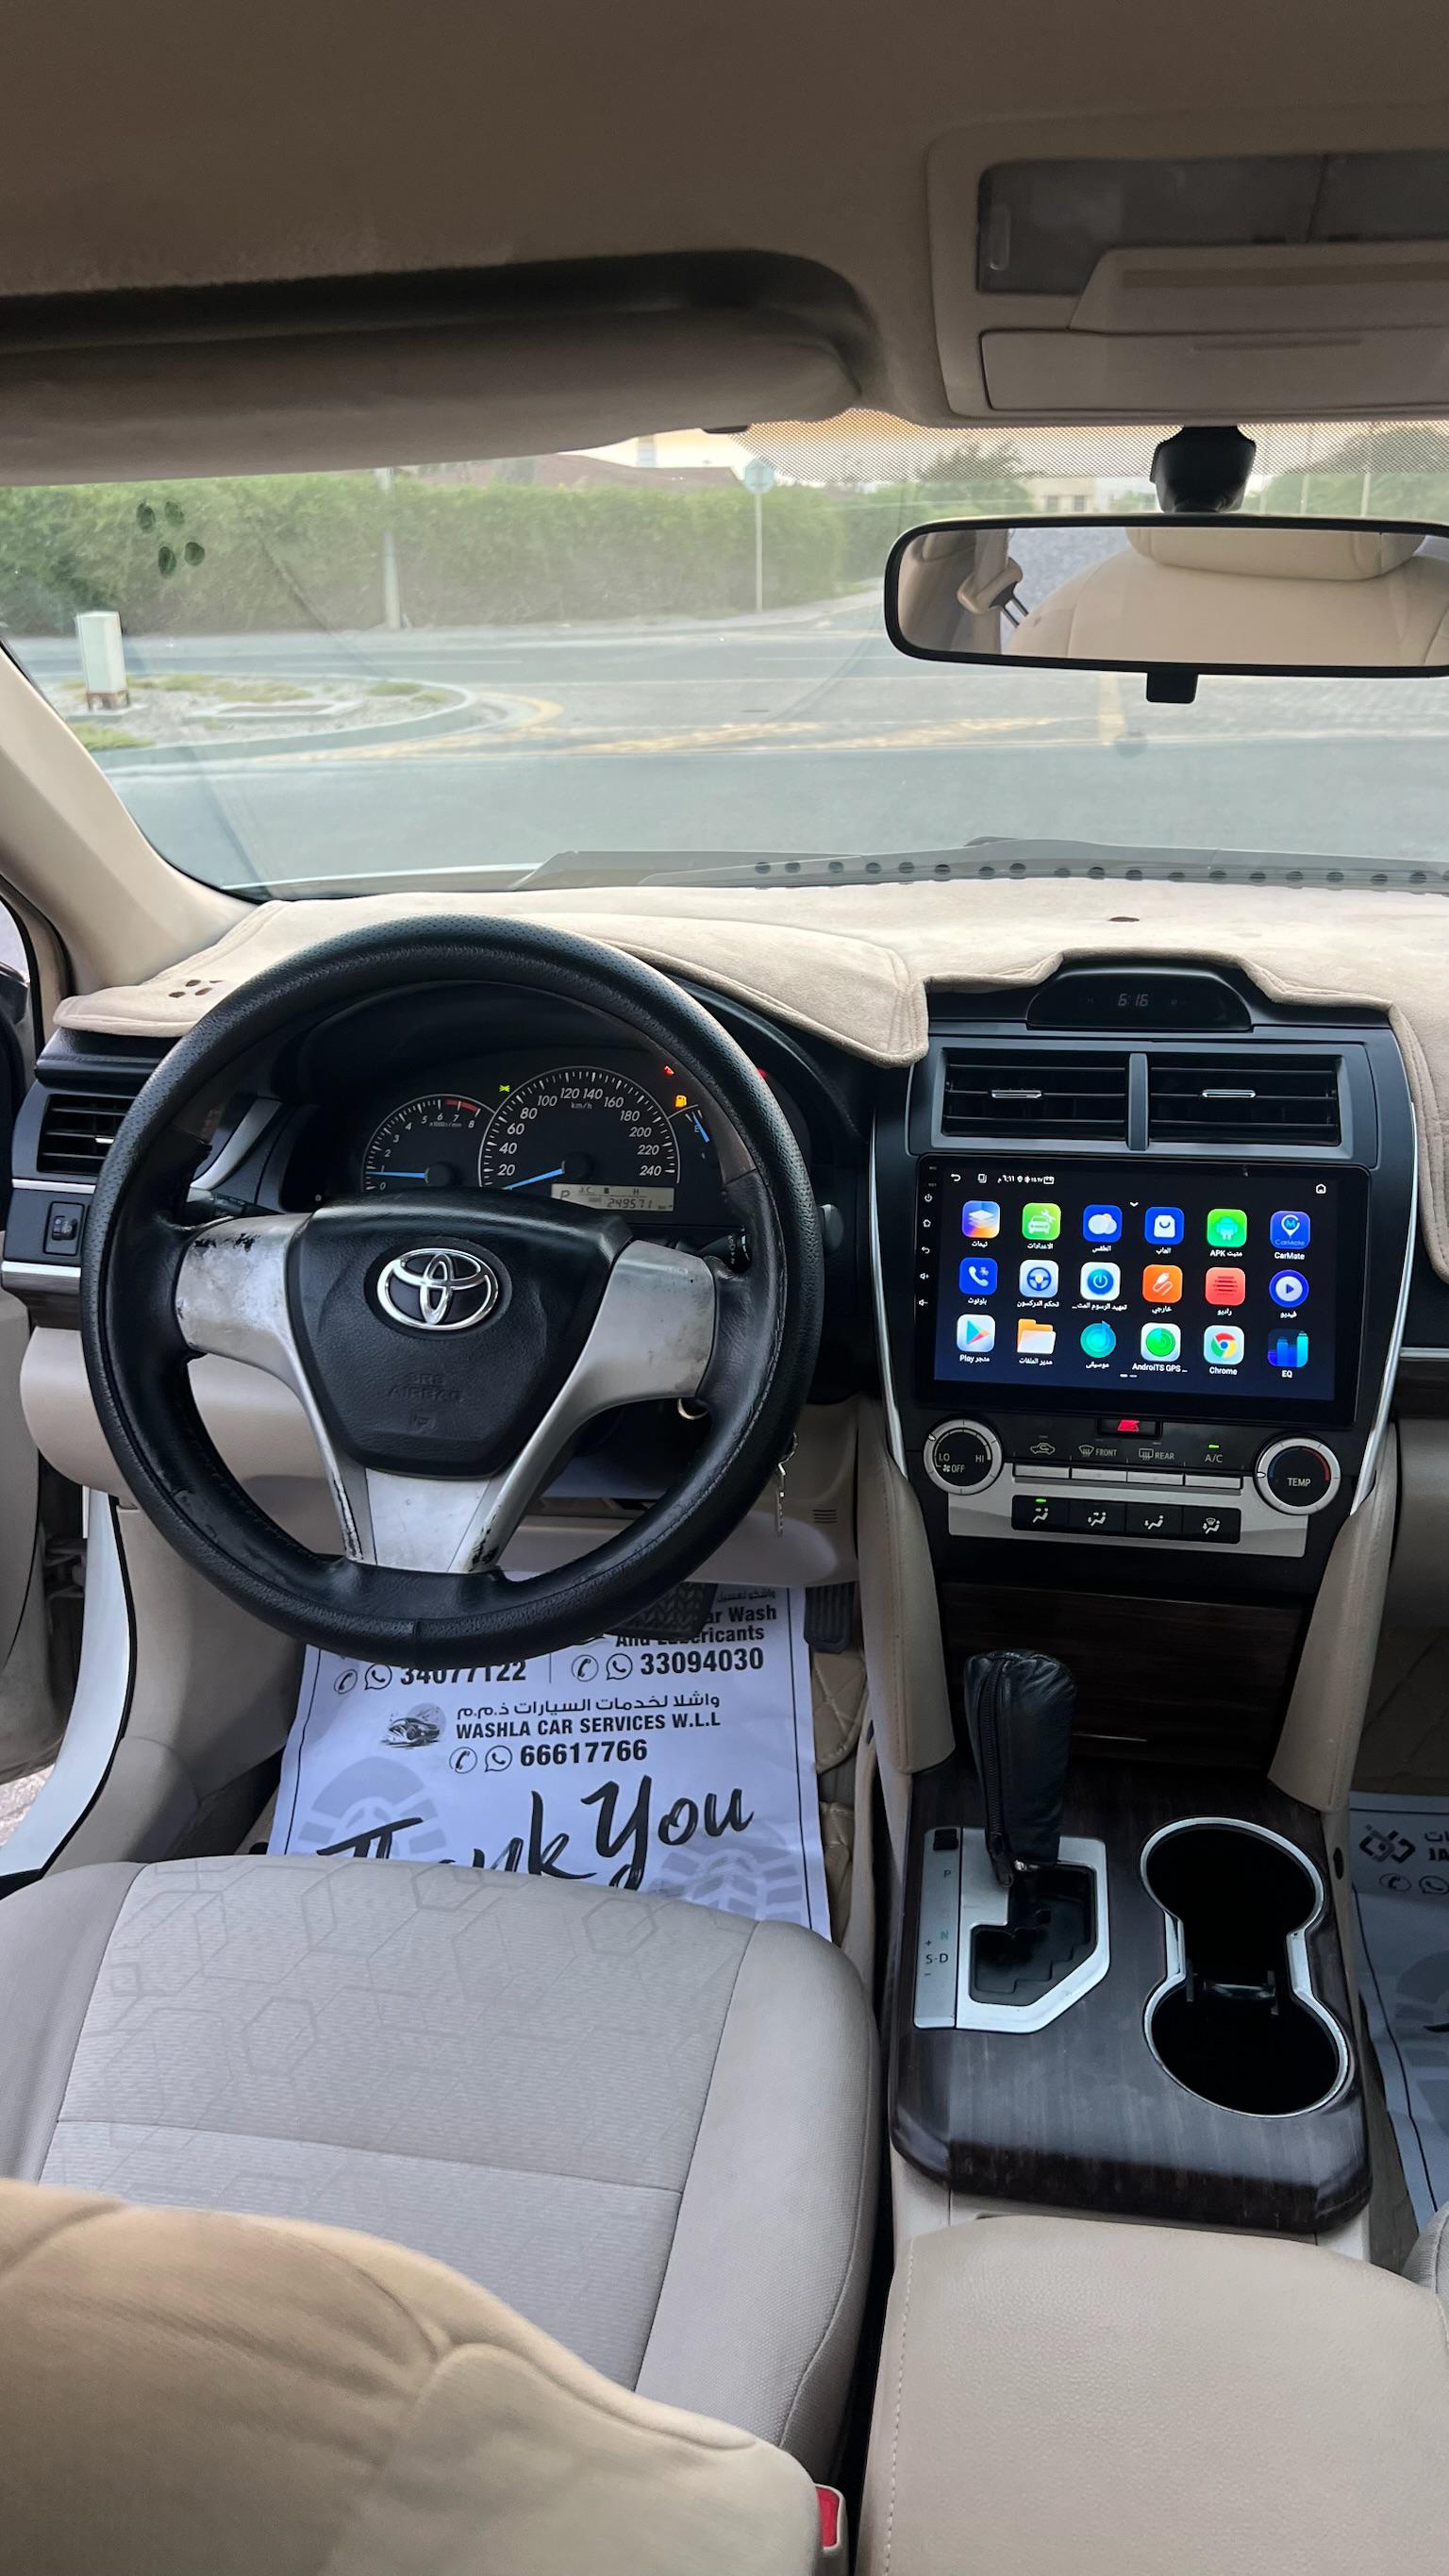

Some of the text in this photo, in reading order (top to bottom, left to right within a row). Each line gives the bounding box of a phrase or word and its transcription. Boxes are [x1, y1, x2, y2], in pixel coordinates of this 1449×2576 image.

[1117, 993, 1149, 1007] 6:16
[560, 1088, 579, 1099] 120
[583, 1088, 604, 1099] 140
[538, 1095, 558, 1107] 100
[604, 1096, 625, 1108] 160
[520, 1107, 538, 1119] 80
[620, 1110, 641, 1122] 180
[507, 1123, 525, 1135] 60
[629, 1127, 652, 1138] 200
[499, 1142, 518, 1155] 40
[638, 1145, 659, 1156] 220
[497, 1163, 516, 1177] 20
[640, 1165, 662, 1177] 240
[607, 1197, 653, 1209] 249571
[1209, 1248, 1225, 1257] APK
[1274, 1251, 1306, 1261] CarMate
[1043, 1300, 1059, 1310] تحكم
[1217, 1308, 1232, 1316] راديو
[959, 1354, 974, 1363] Play
[1132, 1363, 1165, 1371] AndroiTS
[1208, 1366, 1238, 1375] Chrome
[1281, 1370, 1292, 1379] EQ
[939, 1453, 950, 1462] LO
[1095, 1448, 1118, 1457] FRONT
[1155, 1451, 1174, 1460] REAR
[974, 1454, 985, 1463] HI
[1205, 1453, 1224, 1464] A/C
[951, 1464, 965, 1473] OFF
[1287, 1477, 1311, 1487] TEMP
[728, 1604, 777, 1622] Wash
[641, 1648, 764, 1676] 33094030
[595, 1696, 669, 1711] لخدمات
[674, 1691, 720, 1708] واشلا
[514, 1698, 591, 1716] السيارات
[457, 1712, 721, 1739] WASHLA CAR SERVICES W.L.L
[520, 1738, 648, 1766] 66617766
[580, 1775, 755, 1890] You
[943, 1869, 951, 1879] P
[940, 1931, 949, 1940] N
